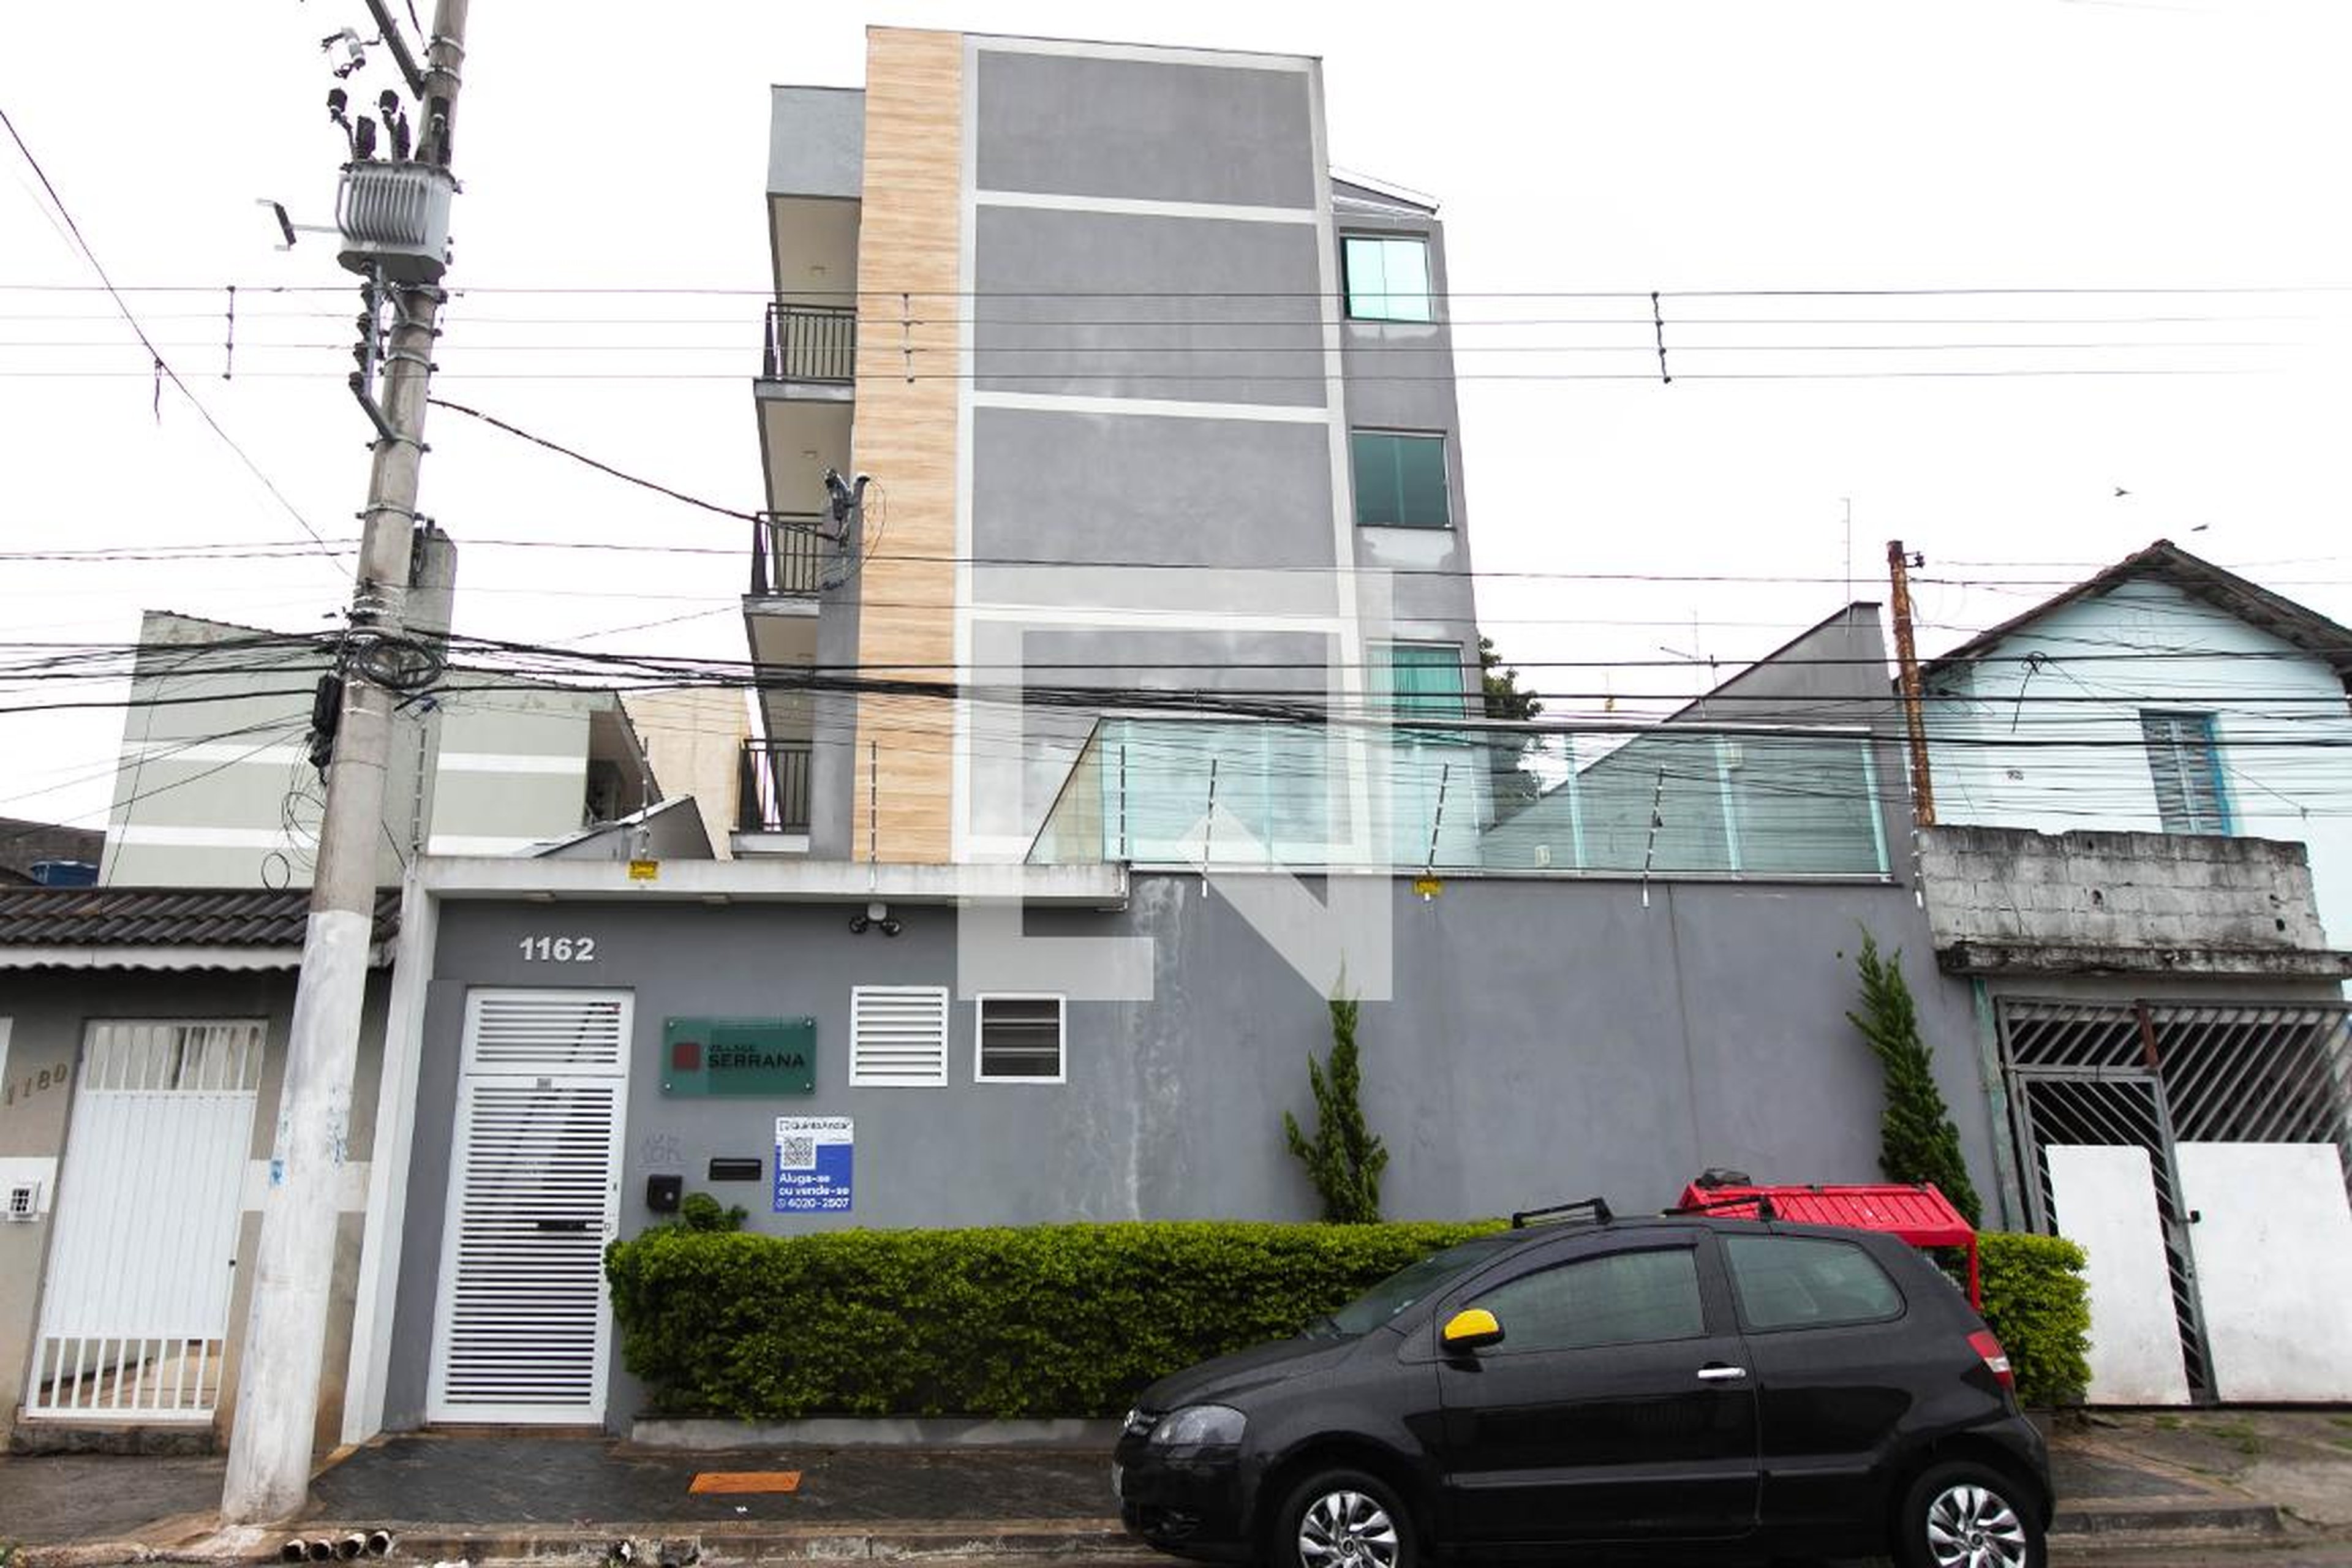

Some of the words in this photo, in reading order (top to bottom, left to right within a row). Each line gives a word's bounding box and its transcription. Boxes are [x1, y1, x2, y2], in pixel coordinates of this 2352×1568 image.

[520, 937, 595, 961] 1162
[708, 1053, 805, 1069] SERRANA
[779, 1173, 831, 1185] Aluga-se
[779, 1187, 793, 1196] ou
[796, 1185, 850, 1196] vende-se
